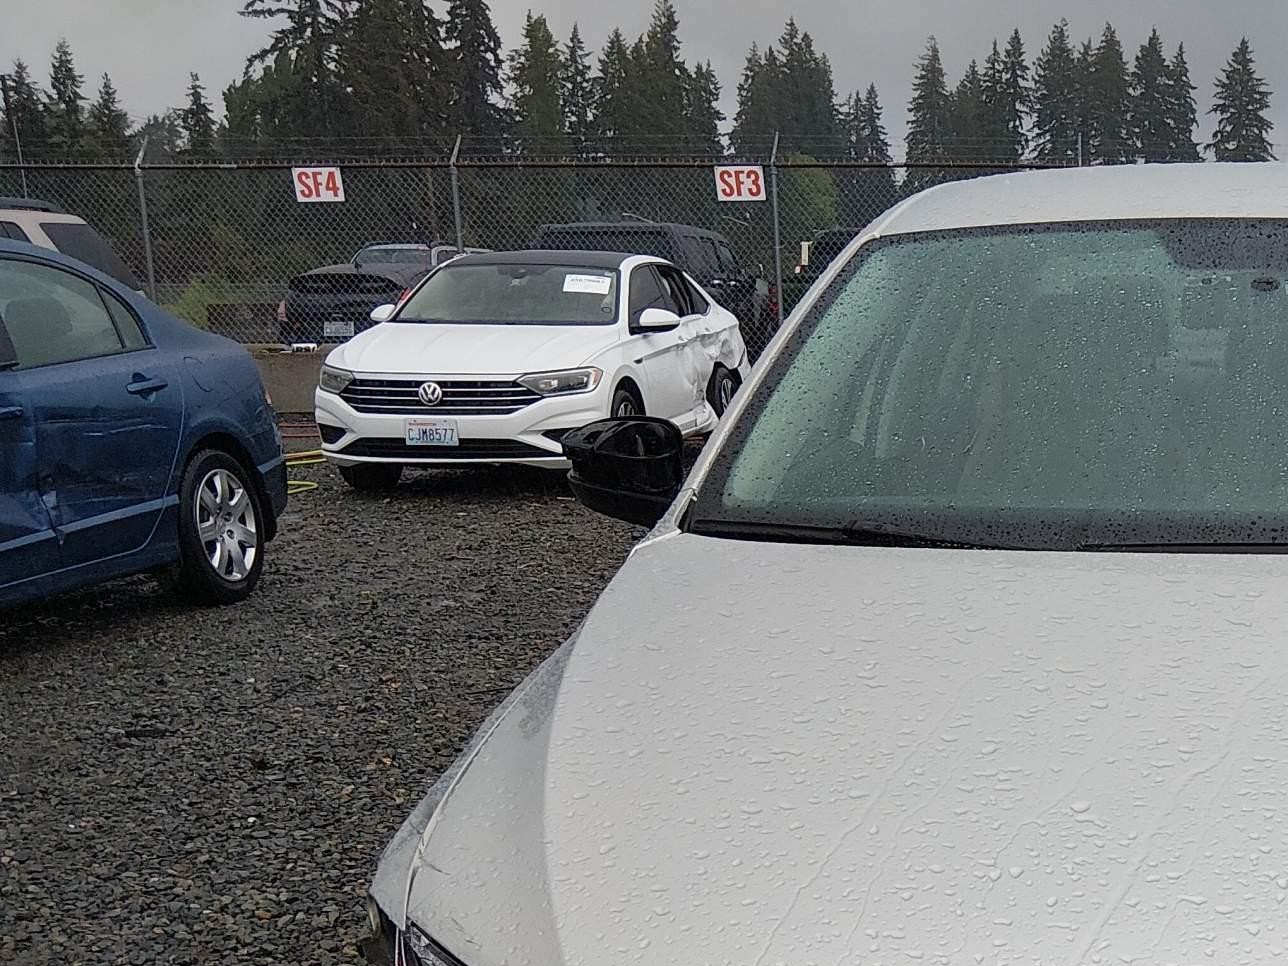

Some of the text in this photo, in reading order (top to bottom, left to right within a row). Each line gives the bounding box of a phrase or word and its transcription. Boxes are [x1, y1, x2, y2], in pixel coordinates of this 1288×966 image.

[296, 171, 340, 198] SF4
[719, 170, 761, 197] SF3
[407, 427, 455, 441] CJM8577
